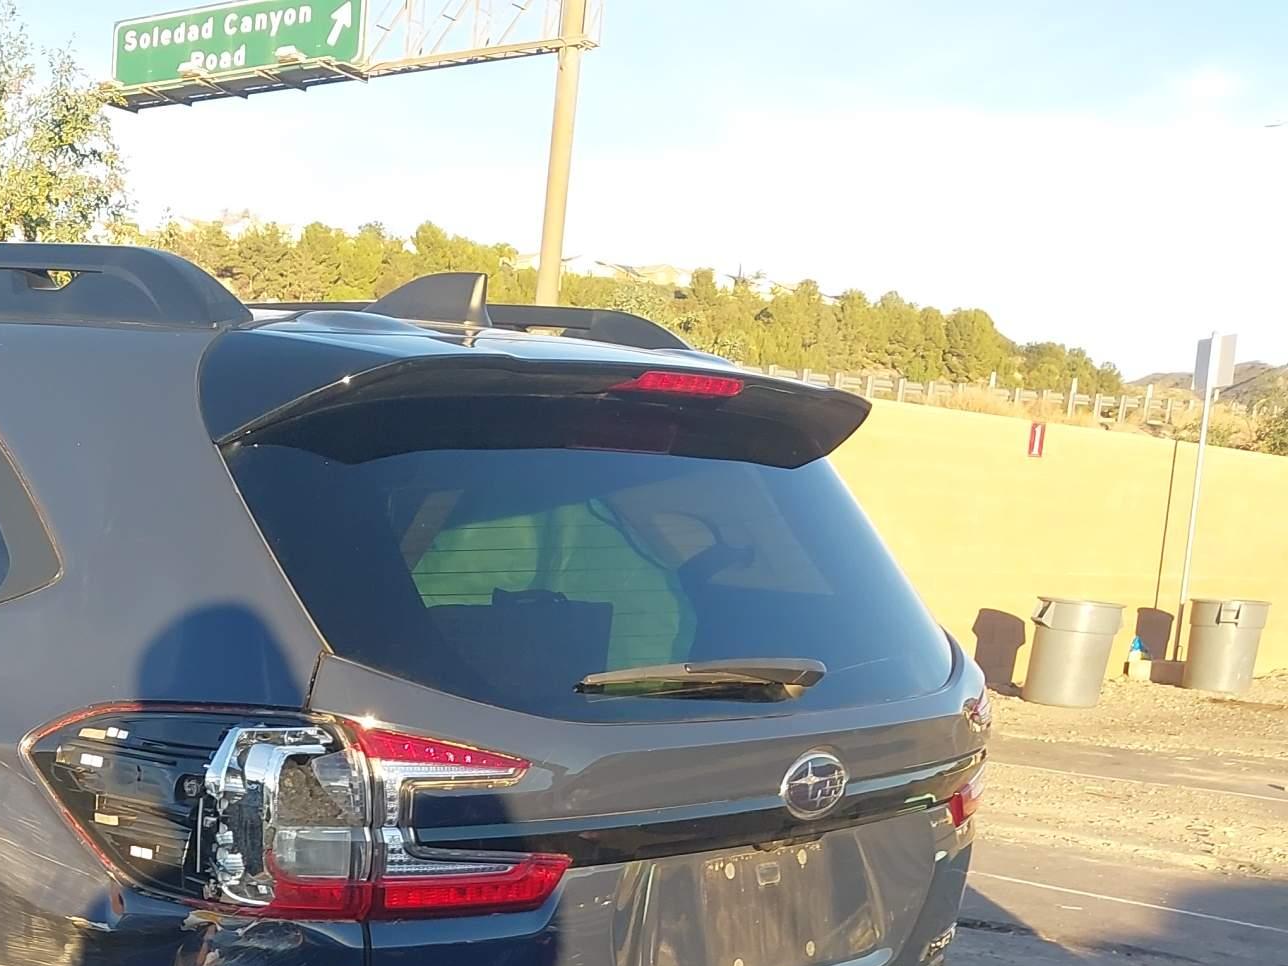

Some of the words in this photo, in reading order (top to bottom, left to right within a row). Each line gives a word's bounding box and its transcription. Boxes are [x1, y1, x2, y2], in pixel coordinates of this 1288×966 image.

[124, 16, 214, 52] Soledad
[223, 5, 312, 37] Canyon
[1032, 424, 1042, 455] 1
